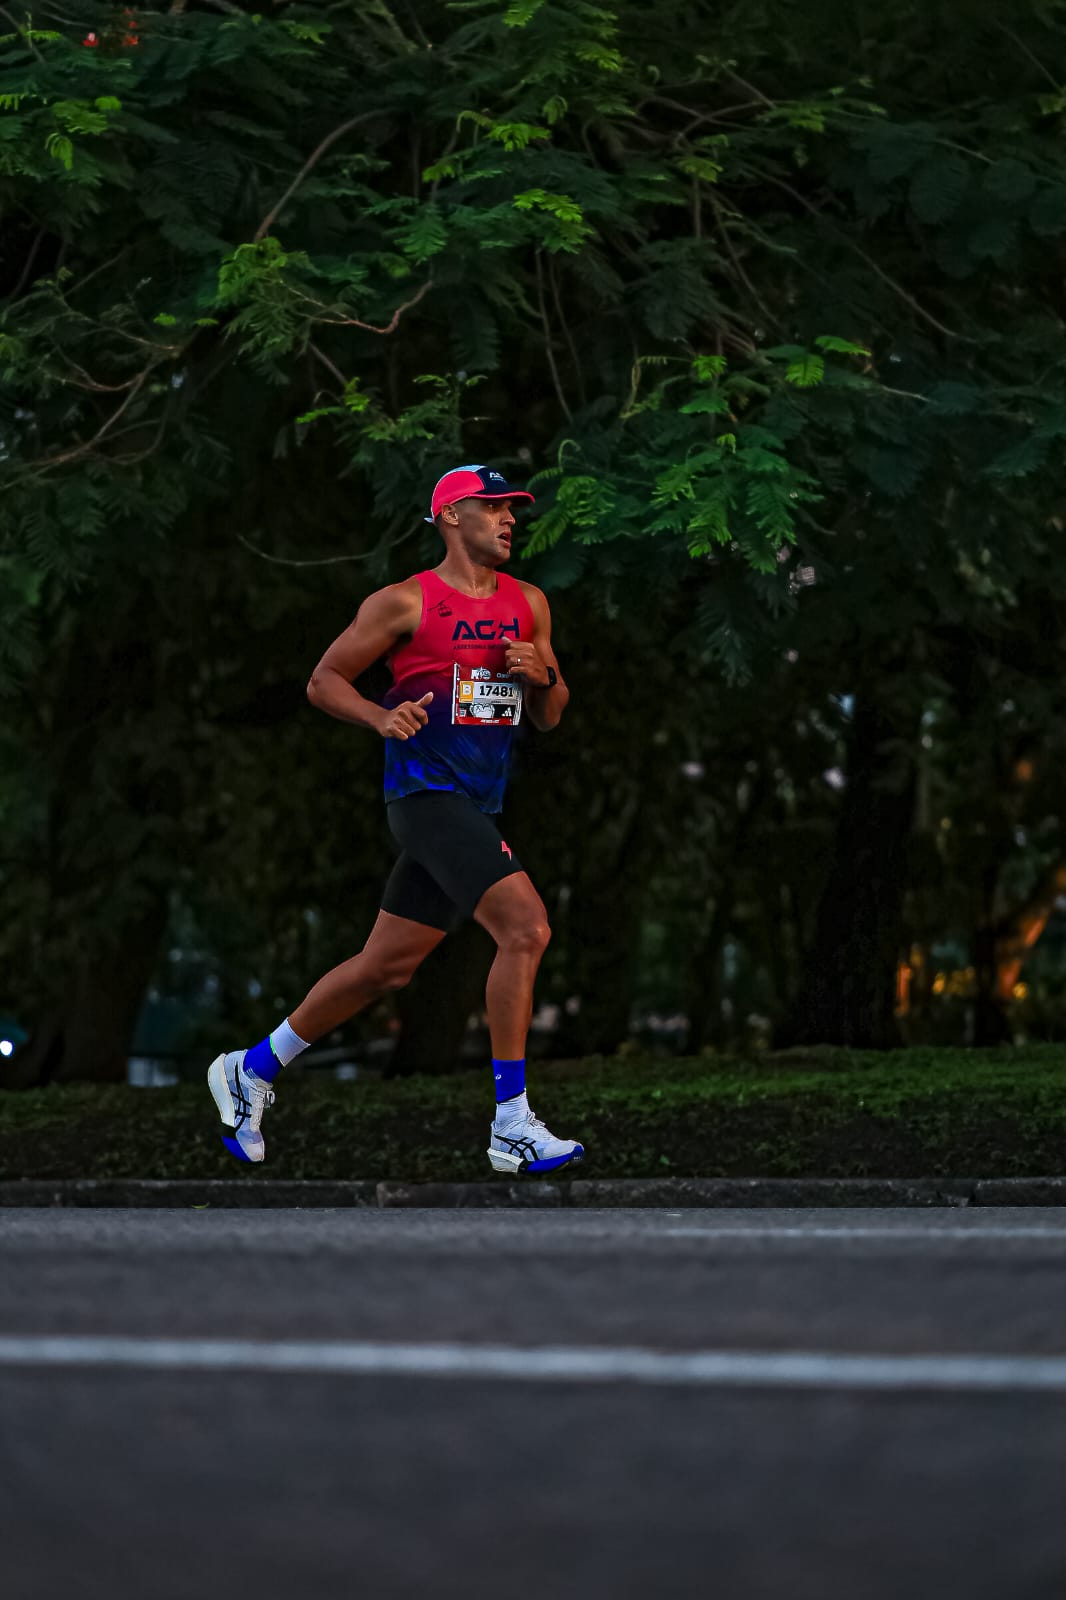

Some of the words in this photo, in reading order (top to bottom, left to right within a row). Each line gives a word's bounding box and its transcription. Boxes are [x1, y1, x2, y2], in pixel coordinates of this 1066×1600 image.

[452, 618, 520, 641] ACH
[463, 684, 472, 695] B
[479, 685, 514, 697] 17481
